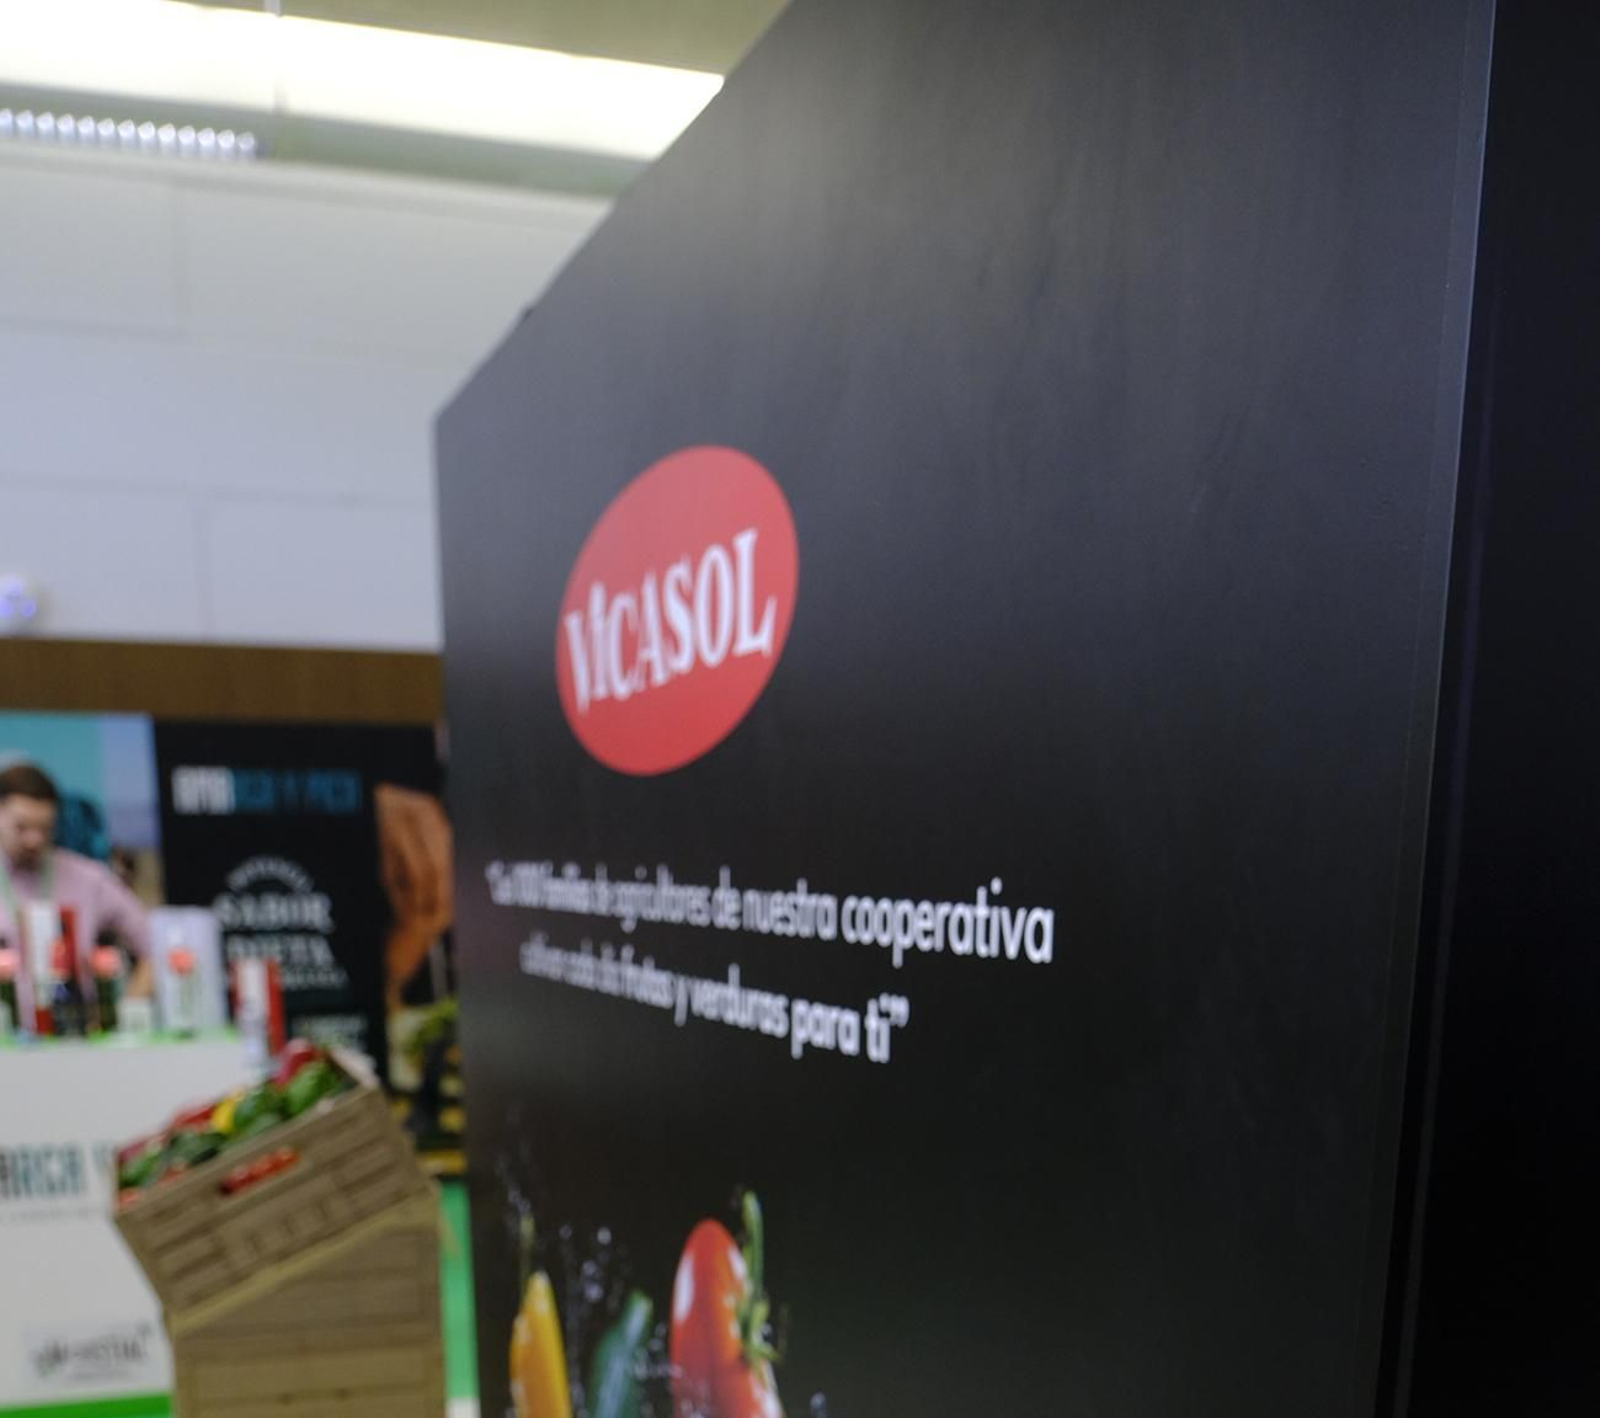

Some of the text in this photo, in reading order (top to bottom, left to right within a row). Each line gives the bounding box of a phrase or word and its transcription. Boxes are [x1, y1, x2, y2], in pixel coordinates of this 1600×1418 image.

[564, 527, 778, 717] VICASOL
[712, 865, 742, 931] de
[743, 878, 838, 940] nuestra
[842, 877, 1054, 968] cooperativa
[672, 974, 691, 1027] y
[689, 963, 790, 1038] verduras
[791, 998, 860, 1060] para
